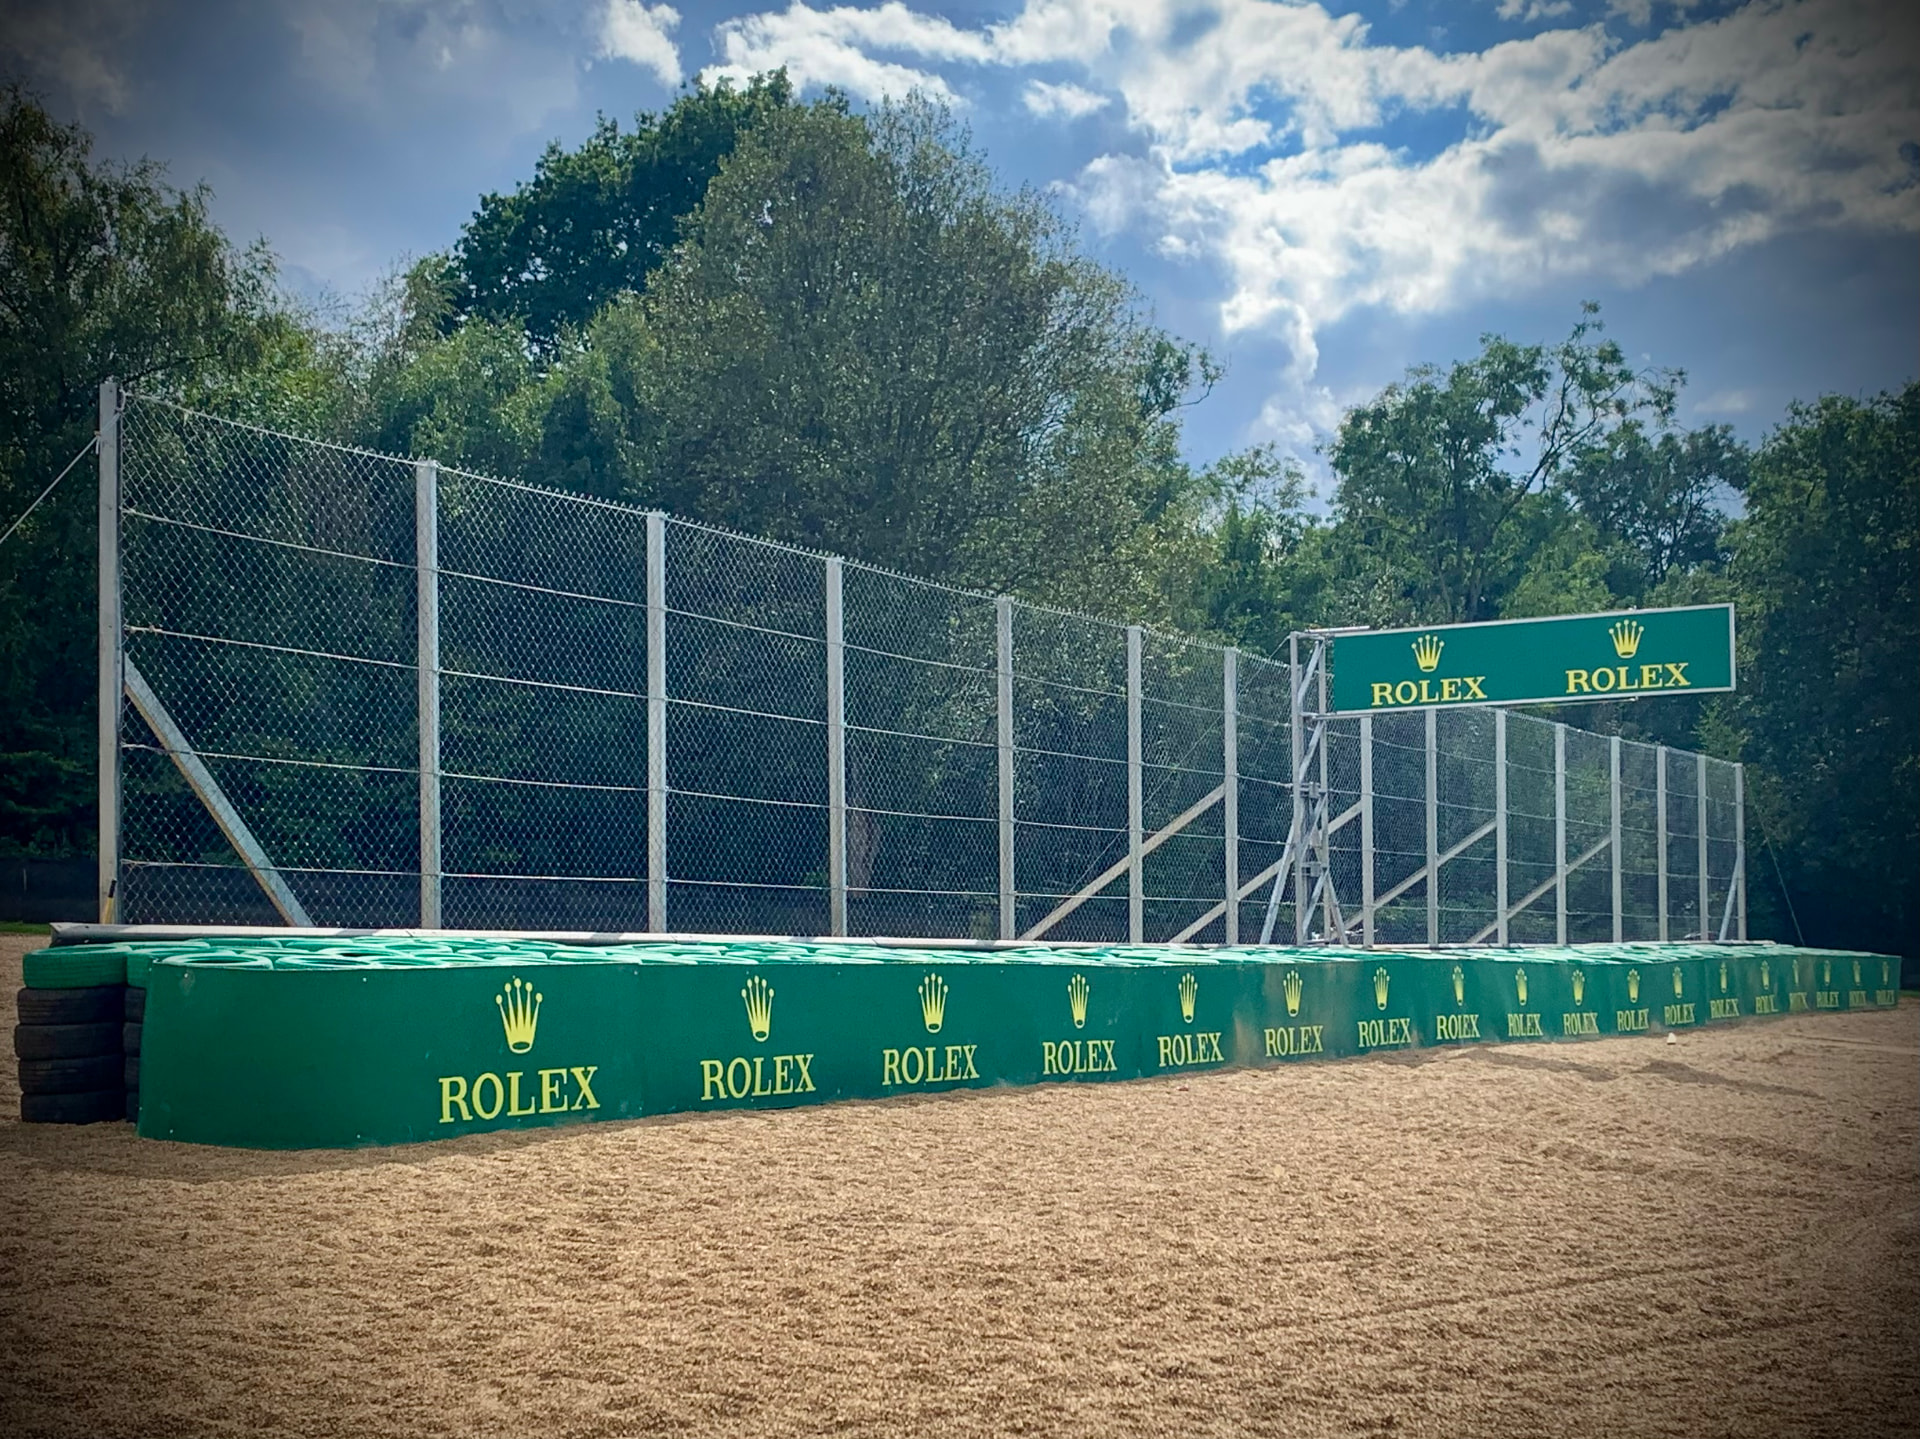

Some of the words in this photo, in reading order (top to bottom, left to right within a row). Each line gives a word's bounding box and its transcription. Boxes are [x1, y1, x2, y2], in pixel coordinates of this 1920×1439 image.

[1371, 676, 1487, 706] ROLEX
[1565, 662, 1690, 694] ROLEX
[1563, 1012, 1600, 1035] ROLEX
[1616, 1008, 1650, 1032] ROLEX
[1664, 1003, 1696, 1026] ROLEX
[1709, 998, 1740, 1019] ROLEX
[1357, 1018, 1412, 1048] ROLEX
[1436, 1014, 1481, 1040] ROLEX
[1507, 1013, 1543, 1037] ROLEX
[1157, 1032, 1225, 1067] ROLEX
[1263, 1025, 1324, 1057] ROLEX
[882, 1045, 980, 1086] ROLEX
[1042, 1039, 1117, 1075] ROLEX
[700, 1054, 816, 1101] ROLEX
[438, 1066, 600, 1123] ROLEX
